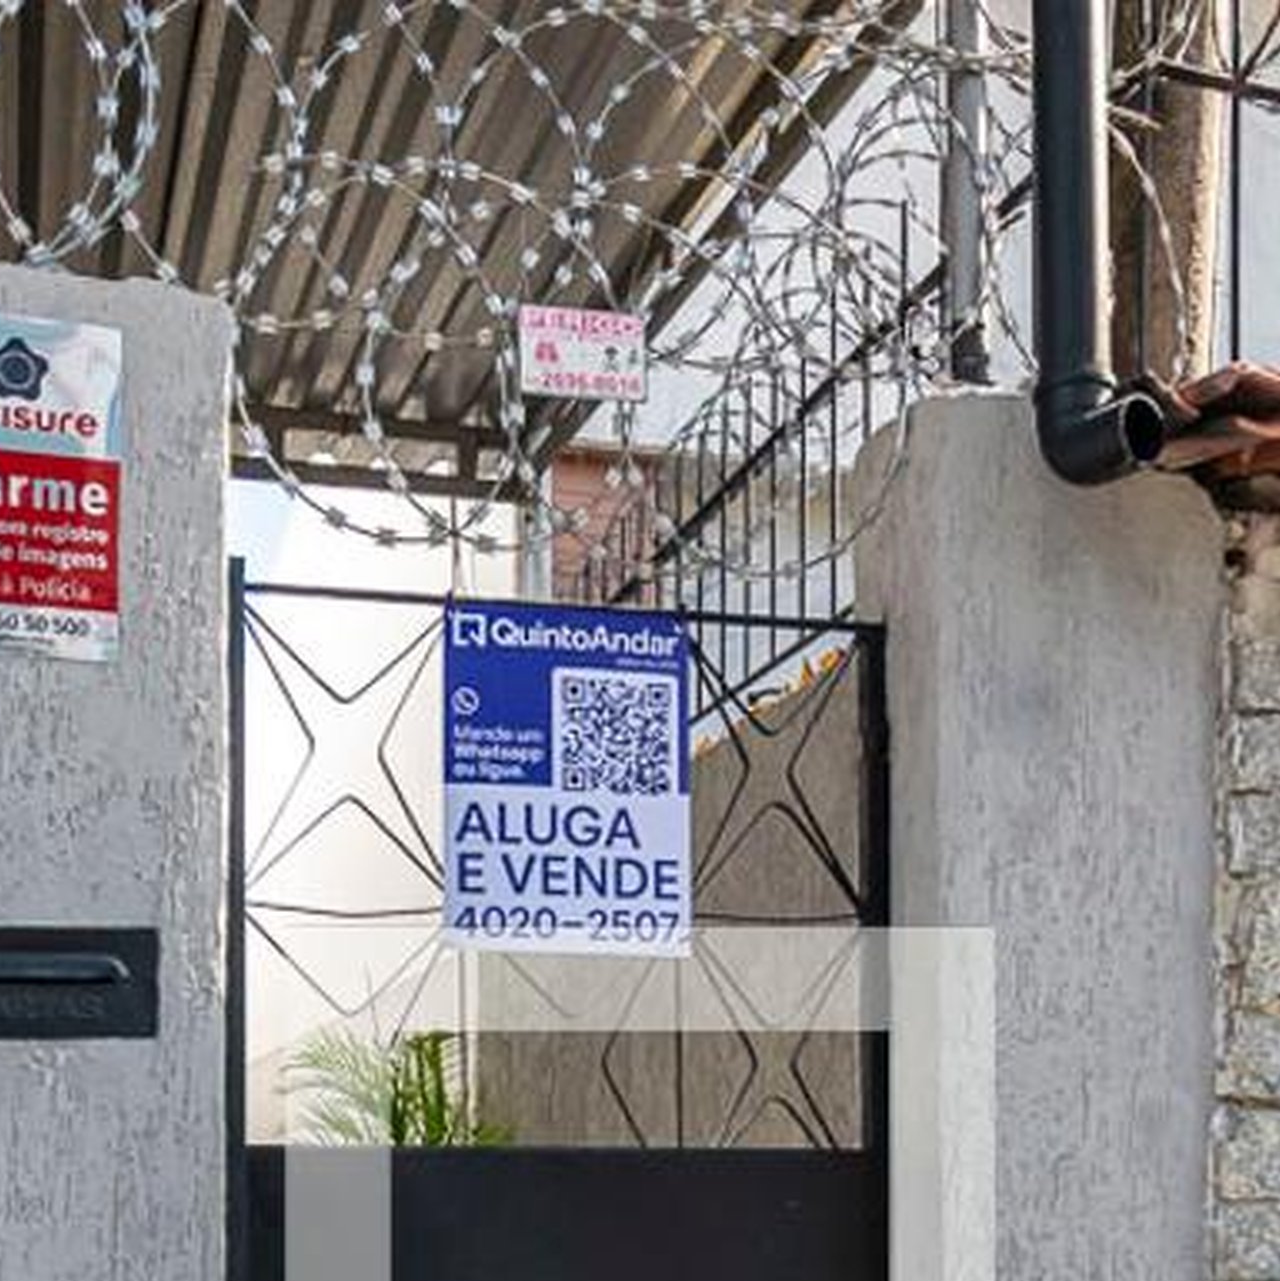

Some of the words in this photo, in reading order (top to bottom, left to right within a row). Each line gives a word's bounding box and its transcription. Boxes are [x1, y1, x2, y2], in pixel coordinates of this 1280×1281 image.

[32, 523, 109, 545] registro
[18, 542, 108, 571] imagens
[490, 618, 681, 657] QuintoAndar
[455, 801, 641, 849] ALUGA
[457, 853, 486, 895] E
[501, 853, 681, 901] VENDE
[453, 905, 682, 944] 4020-2507
